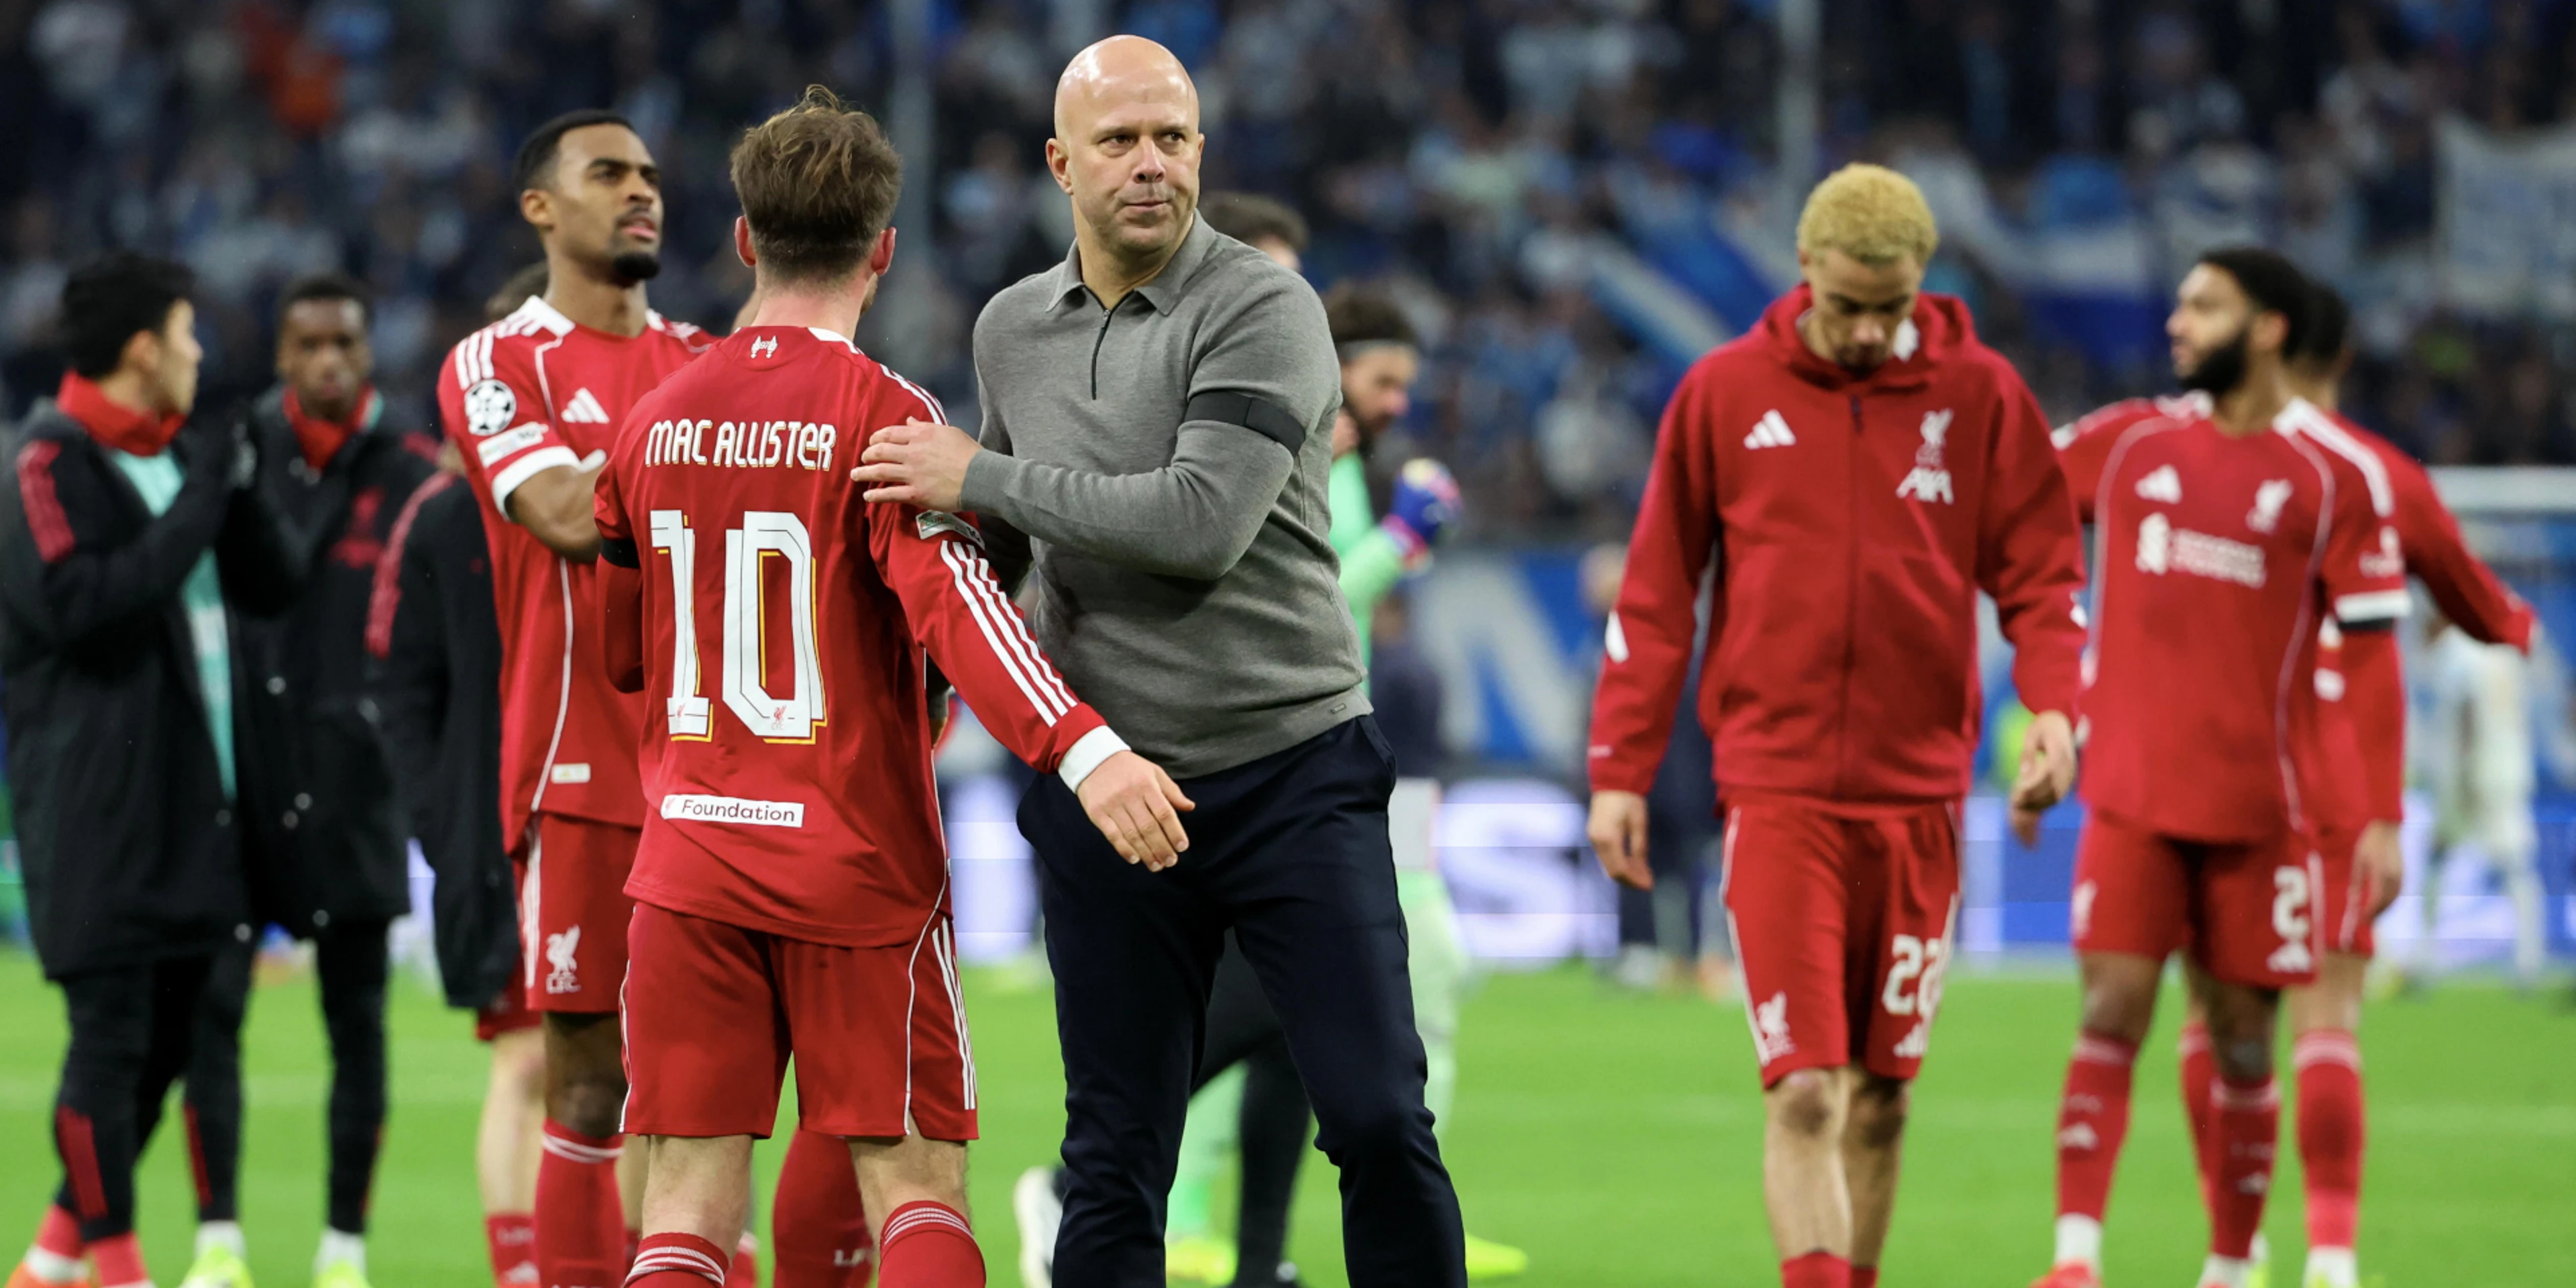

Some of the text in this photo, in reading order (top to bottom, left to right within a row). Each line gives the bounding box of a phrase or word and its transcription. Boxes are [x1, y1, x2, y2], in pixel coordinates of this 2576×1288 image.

[645, 418, 837, 471] MAC ALLISTER
[1896, 468, 1954, 505] AXA
[650, 510, 828, 745] 10
[682, 800, 795, 822] Foundation
[2272, 865, 2310, 940] 2
